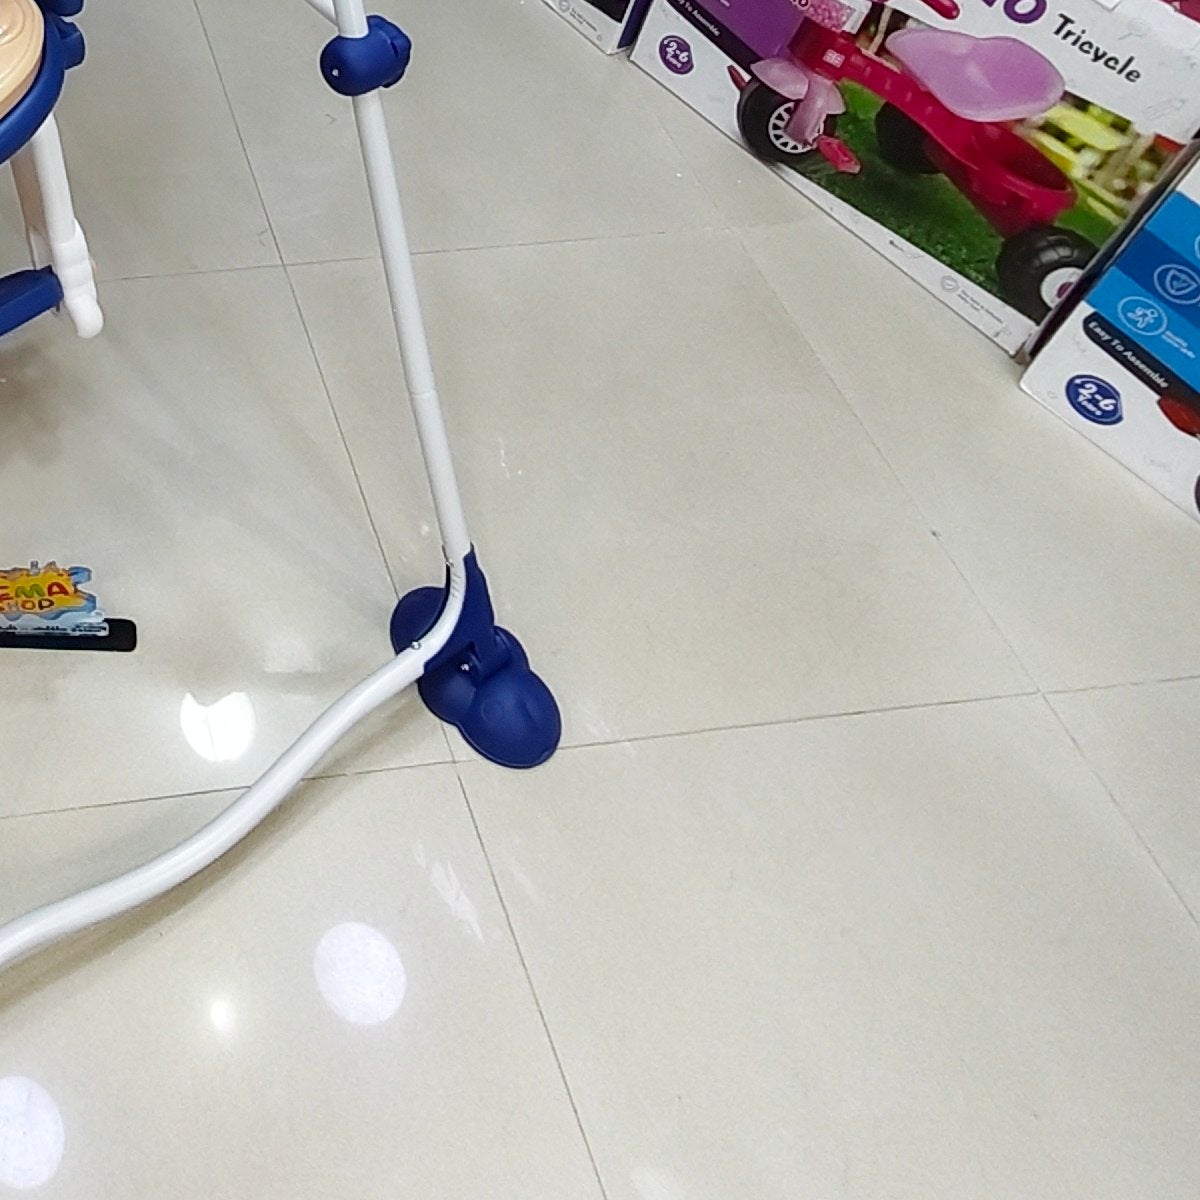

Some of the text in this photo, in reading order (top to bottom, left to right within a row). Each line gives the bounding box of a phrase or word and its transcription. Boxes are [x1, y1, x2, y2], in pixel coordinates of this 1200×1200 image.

[692, 9, 720, 37] Assemble
[666, 41, 689, 63] 2-6
[1053, 13, 1141, 84] Tricycle
[1088, 321, 1169, 389] Easy To Assemble
[1078, 383, 1117, 412] 2-6
